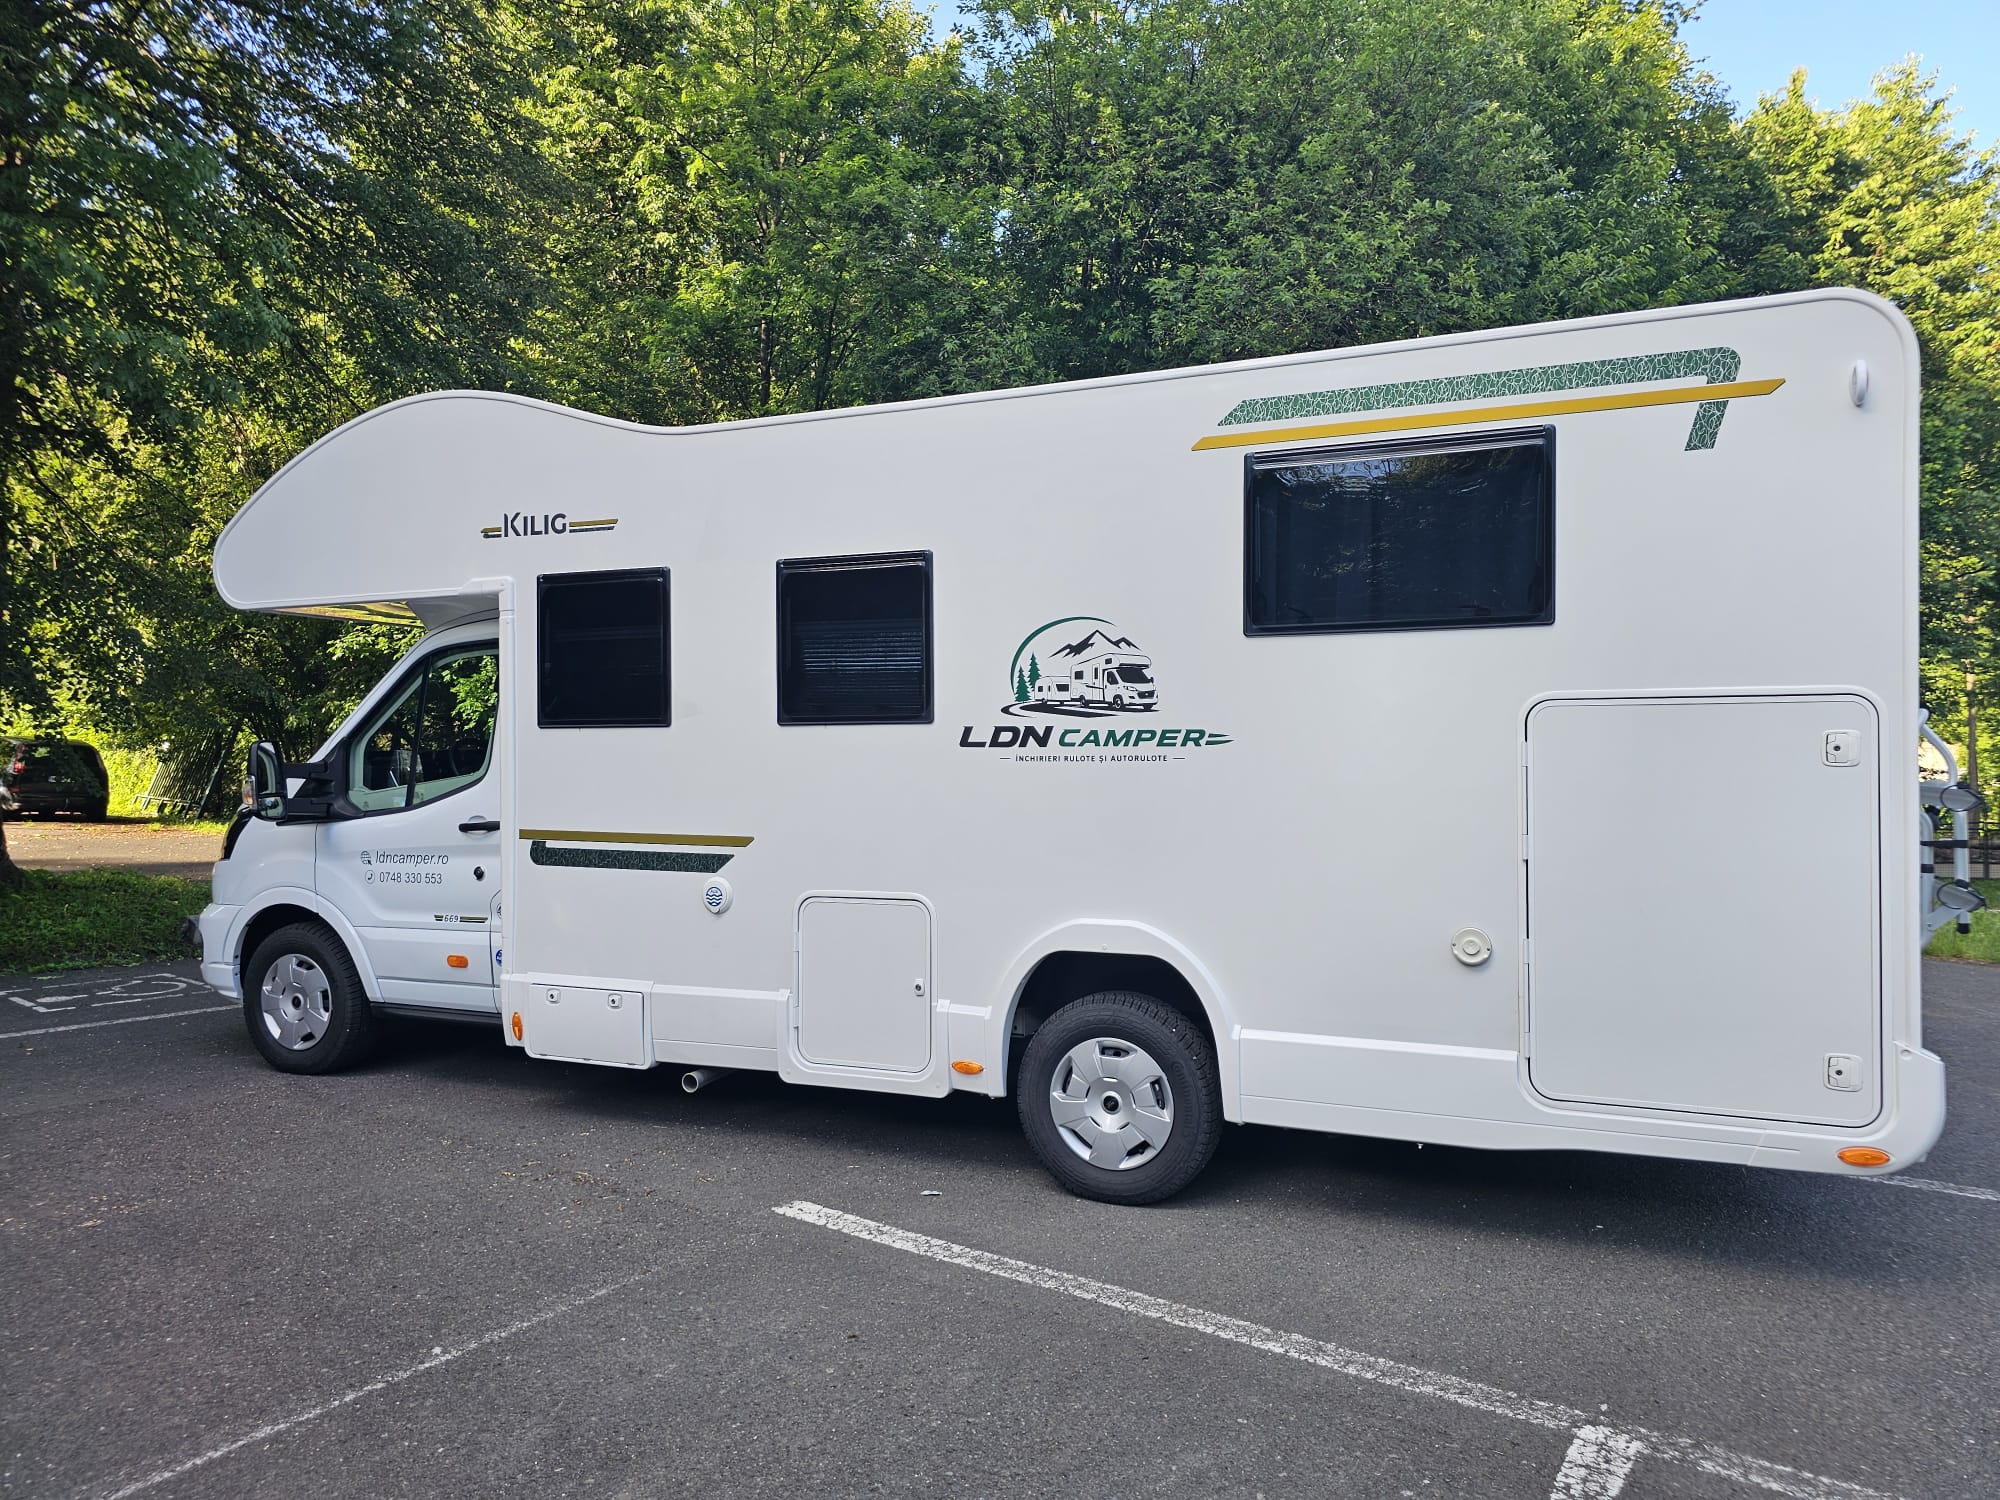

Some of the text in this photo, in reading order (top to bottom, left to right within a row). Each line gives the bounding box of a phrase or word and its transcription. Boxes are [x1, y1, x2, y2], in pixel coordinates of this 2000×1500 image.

[503, 511, 567, 537] KILIG
[959, 725, 1206, 748] LDN CAMPER
[1063, 754, 1096, 763] RULOTE
[1110, 754, 1168, 763] AUTORULOTE
[375, 850, 449, 868] ldncamper.ro
[379, 871, 443, 885] 0748 330 553
[444, 914, 459, 923] 669
